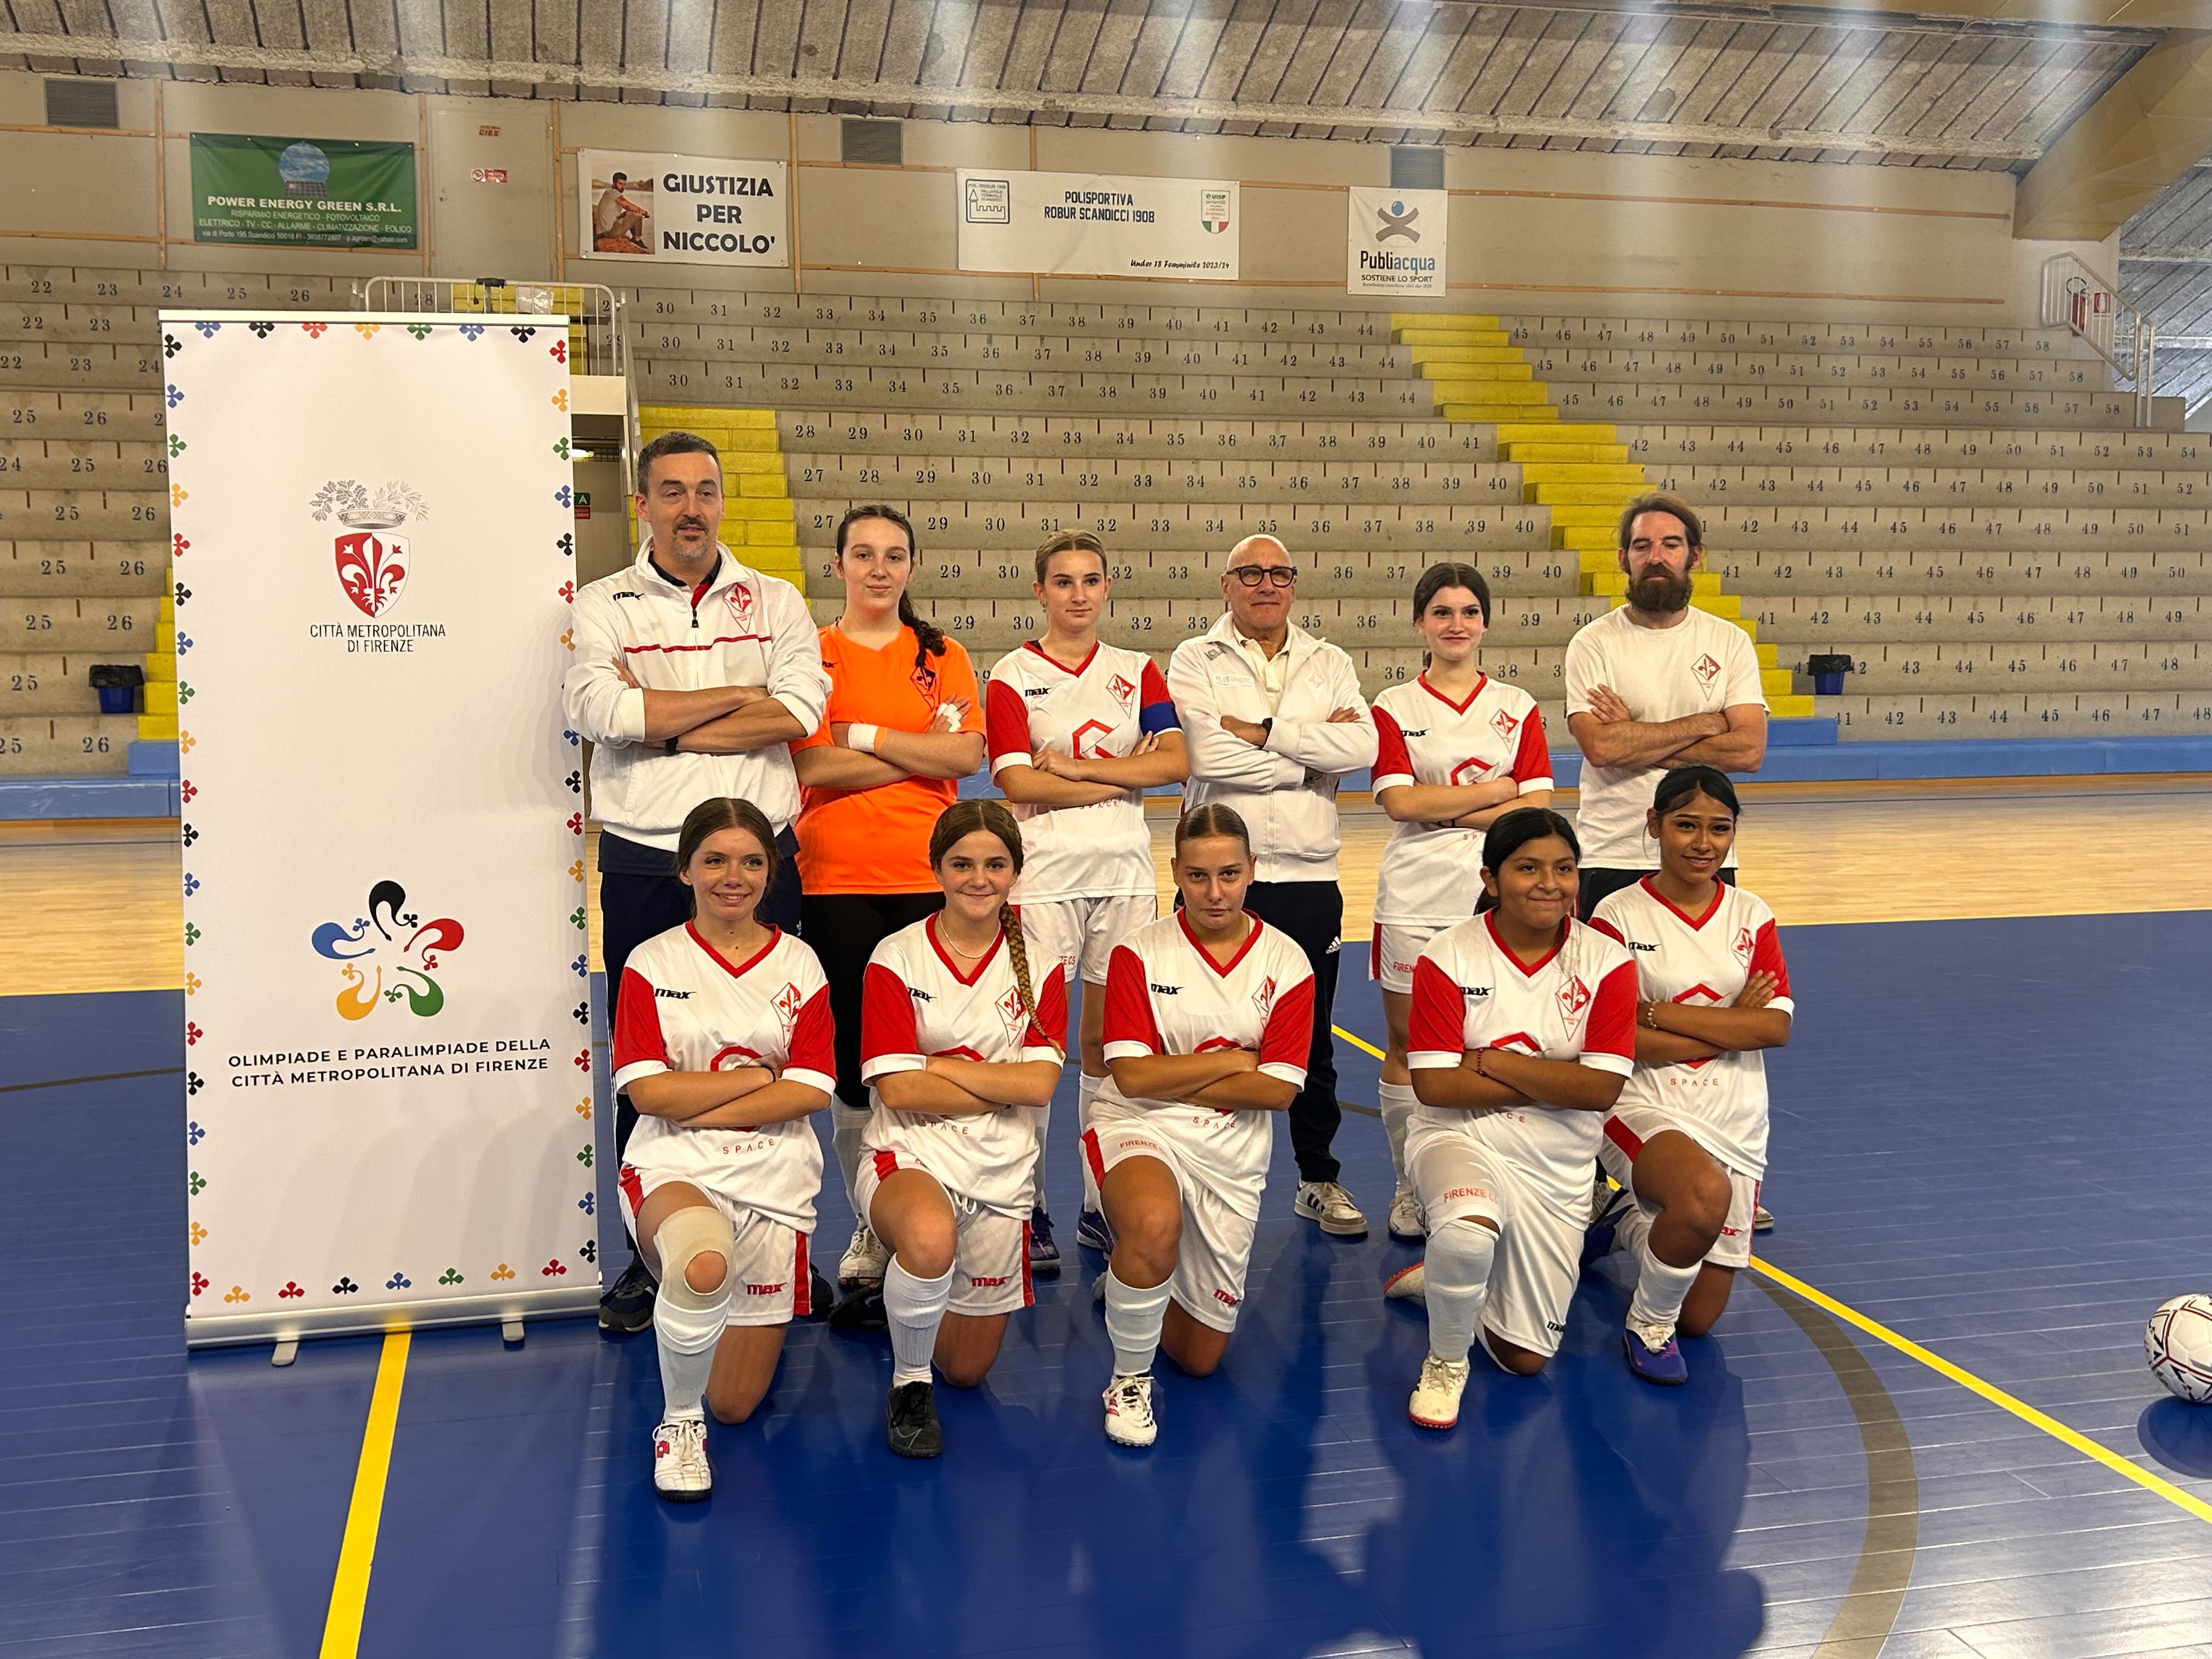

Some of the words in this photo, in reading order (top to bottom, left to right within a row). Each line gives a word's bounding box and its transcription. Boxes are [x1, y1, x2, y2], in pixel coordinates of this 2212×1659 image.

[663, 173, 774, 197] GIUSTIZIA
[207, 196, 256, 207] POWER
[259, 199, 313, 210] ENERGY
[317, 201, 362, 211] GREEN
[365, 202, 402, 212] S.R.L.
[1065, 191, 1133, 207] POLISPORTIVA
[231, 210, 272, 218] RISPARMIO
[273, 211, 320, 221] ENERGETICO
[326, 213, 380, 222] FOTOVOLTAICO
[697, 204, 742, 224] PER
[1044, 206, 1076, 220] ROBUR
[1079, 208, 1130, 222] SCANDICCI
[1132, 210, 1155, 223] 1908
[199, 218, 240, 227] ELETTRICO
[278, 222, 312, 230] ALLARME
[317, 223, 379, 232] CLIMATIZZAZIONE
[385, 225, 412, 233] EOLICO
[663, 231, 775, 254] NICCOLO'
[1131, 259, 1152, 267] Under
[1164, 260, 1200, 269] Femminile
[1203, 261, 1229, 269] 2023/24
[1361, 250, 1435, 275] Publiacqua
[31, 280, 52, 294] 22
[227, 287, 247, 300] 25
[868, 309, 885, 321] 34
[1019, 314, 1036, 326] 37
[89, 318, 110, 332] 23
[1166, 319, 1182, 330] 40
[1308, 323, 1324, 334] 43
[1638, 331, 1654, 343] 48
[1840, 336, 1855, 347] 53
[717, 338, 735, 351] 31
[879, 344, 895, 356] 34
[1957, 338, 1972, 350] 56
[1035, 348, 1051, 360] 37
[1232, 353, 1248, 365] 41
[70, 358, 92, 371] 23
[1379, 357, 1395, 369] 44
[1581, 361, 1596, 372] 46
[1666, 362, 1681, 374] 48
[1831, 366, 1846, 377] 52
[1951, 368, 1965, 380] 55
[669, 374, 688, 387] 30
[835, 379, 853, 392] 33
[1048, 385, 1065, 397] 37
[1199, 388, 1217, 400] 40
[1348, 390, 1364, 403] 43
[1736, 397, 1752, 408] 49
[1862, 399, 1878, 411] 52
[1984, 401, 1999, 413] 55
[13, 409, 36, 424] 25
[848, 427, 867, 439] 29
[1011, 431, 1029, 444] 32
[1167, 433, 1184, 446] 35
[1319, 436, 1336, 448] 38
[1462, 437, 1480, 449] 41
[1776, 442, 1792, 453] 45
[1915, 443, 1931, 455] 48
[2050, 444, 2065, 457] 51
[2181, 447, 2196, 459] 54
[71, 458, 95, 472] 25
[916, 470, 935, 483] 29
[1134, 475, 1152, 487] 33
[1289, 476, 1308, 490] 36
[1442, 477, 1460, 490] 39
[1709, 478, 1726, 491] 42
[1903, 480, 1920, 493] 46
[2042, 482, 2058, 494] 49
[2177, 482, 2192, 495] 52
[814, 515, 834, 528] 27
[1151, 519, 1170, 532] 33
[1311, 520, 1330, 533] 36
[1515, 520, 1534, 533] 40
[1841, 521, 1858, 533] 44
[2034, 523, 2051, 535] 48
[2174, 523, 2188, 536] 51
[940, 565, 961, 578] 29
[1169, 566, 1188, 579] 33
[1543, 565, 1561, 578] 40
[1774, 566, 1792, 578] 42
[1926, 566, 1944, 578] 45
[2074, 566, 2091, 579] 48
[612, 591, 644, 602] max
[107, 615, 132, 630] 26
[1131, 617, 1152, 630] 32
[1357, 615, 1376, 629] 36
[1863, 611, 1881, 624] 43
[2067, 611, 2084, 624] 47
[310, 622, 343, 638] CITTÀ
[347, 624, 446, 637] METROPOLITANA
[348, 640, 359, 653] DI
[364, 640, 414, 652] FIRENZE
[2008, 659, 2026, 673] 45
[2161, 658, 2179, 671] 48
[1498, 664, 1517, 679] 38
[1025, 687, 1053, 697] max
[1937, 710, 1956, 724] 43
[2092, 709, 2110, 722] 46
[82, 737, 109, 753] 26
[1629, 941, 1661, 952] max
[654, 988, 697, 1000] max
[1151, 983, 1184, 995] max
[228, 1051, 330, 1068] OLIMPIADE
[338, 1049, 347, 1061] E
[354, 1041, 489, 1060] PARALIMPIADE
[496, 1039, 551, 1052] DELLA
[232, 1070, 284, 1087] CITTÀ
[291, 1064, 445, 1084] METROPOLITANA
[452, 1062, 469, 1074] DI
[476, 1058, 548, 1073] FIRENZE
[1444, 1187, 1486, 1203] FIRENZE
